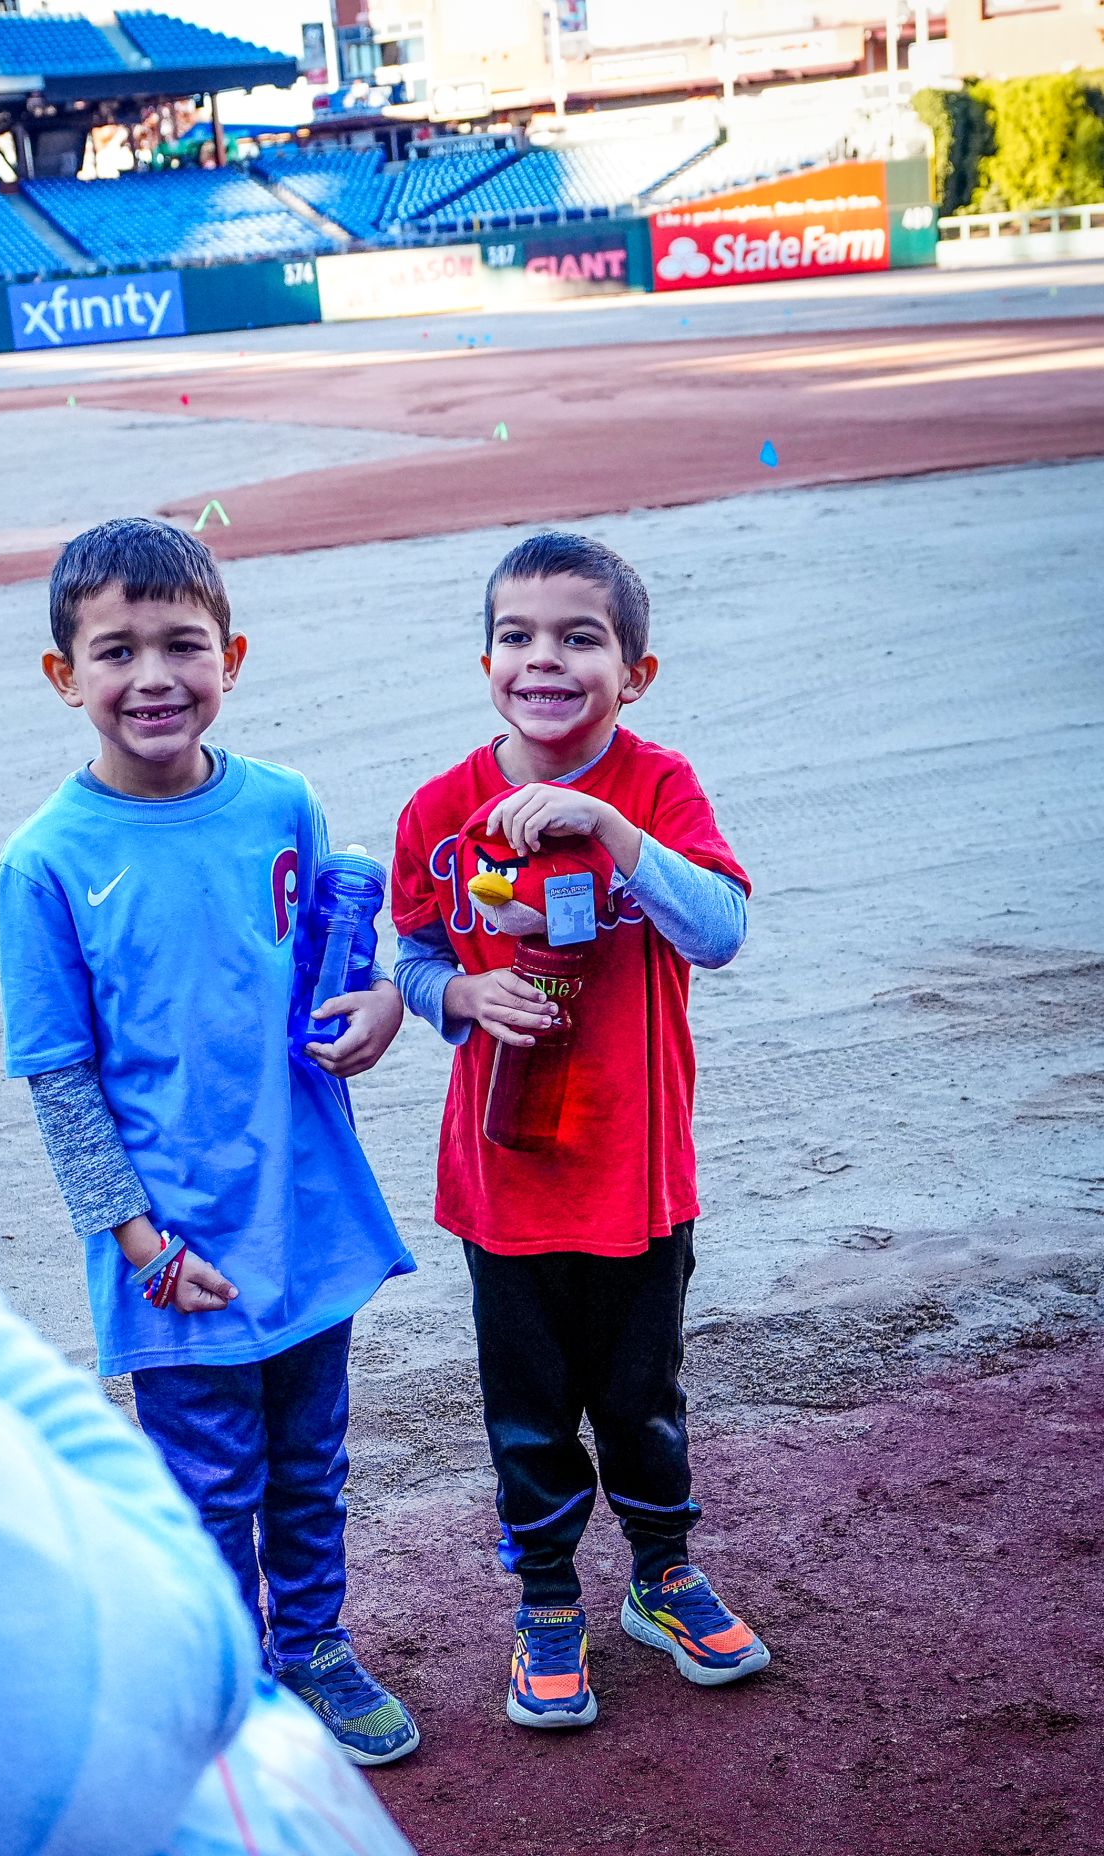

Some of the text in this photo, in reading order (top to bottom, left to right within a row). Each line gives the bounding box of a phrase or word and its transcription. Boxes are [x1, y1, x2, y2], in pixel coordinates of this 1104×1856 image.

[524, 249, 627, 281] GIANT
[20, 281, 173, 345] xfinity
[672, 1578, 704, 1595] S-LIGHTS
[528, 1609, 580, 1618] SKECHERS
[534, 1616, 573, 1624] S-LIGHTS
